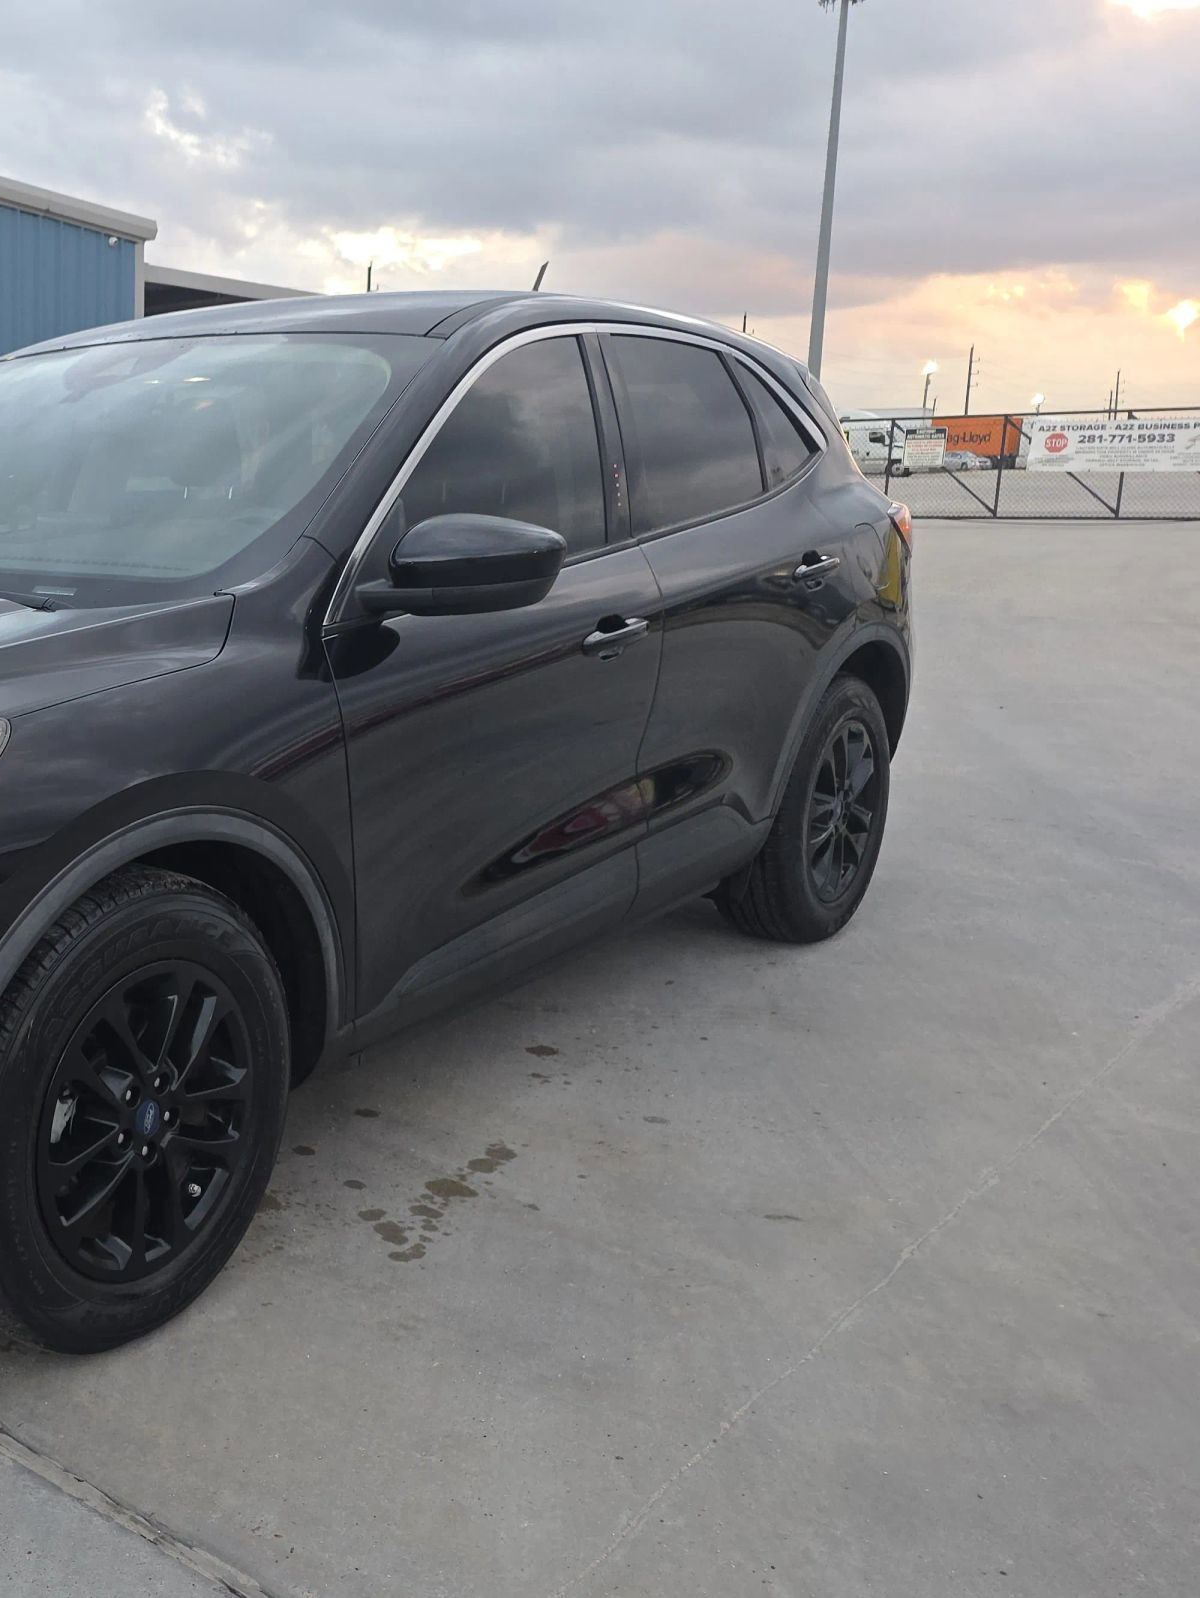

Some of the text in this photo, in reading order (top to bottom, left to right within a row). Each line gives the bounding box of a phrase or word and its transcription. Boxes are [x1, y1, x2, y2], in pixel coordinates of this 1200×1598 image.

[1137, 422, 1190, 430] BUSINESS
[1046, 438, 1067, 447] STOP
[1078, 433, 1175, 443] 281-771-5933
